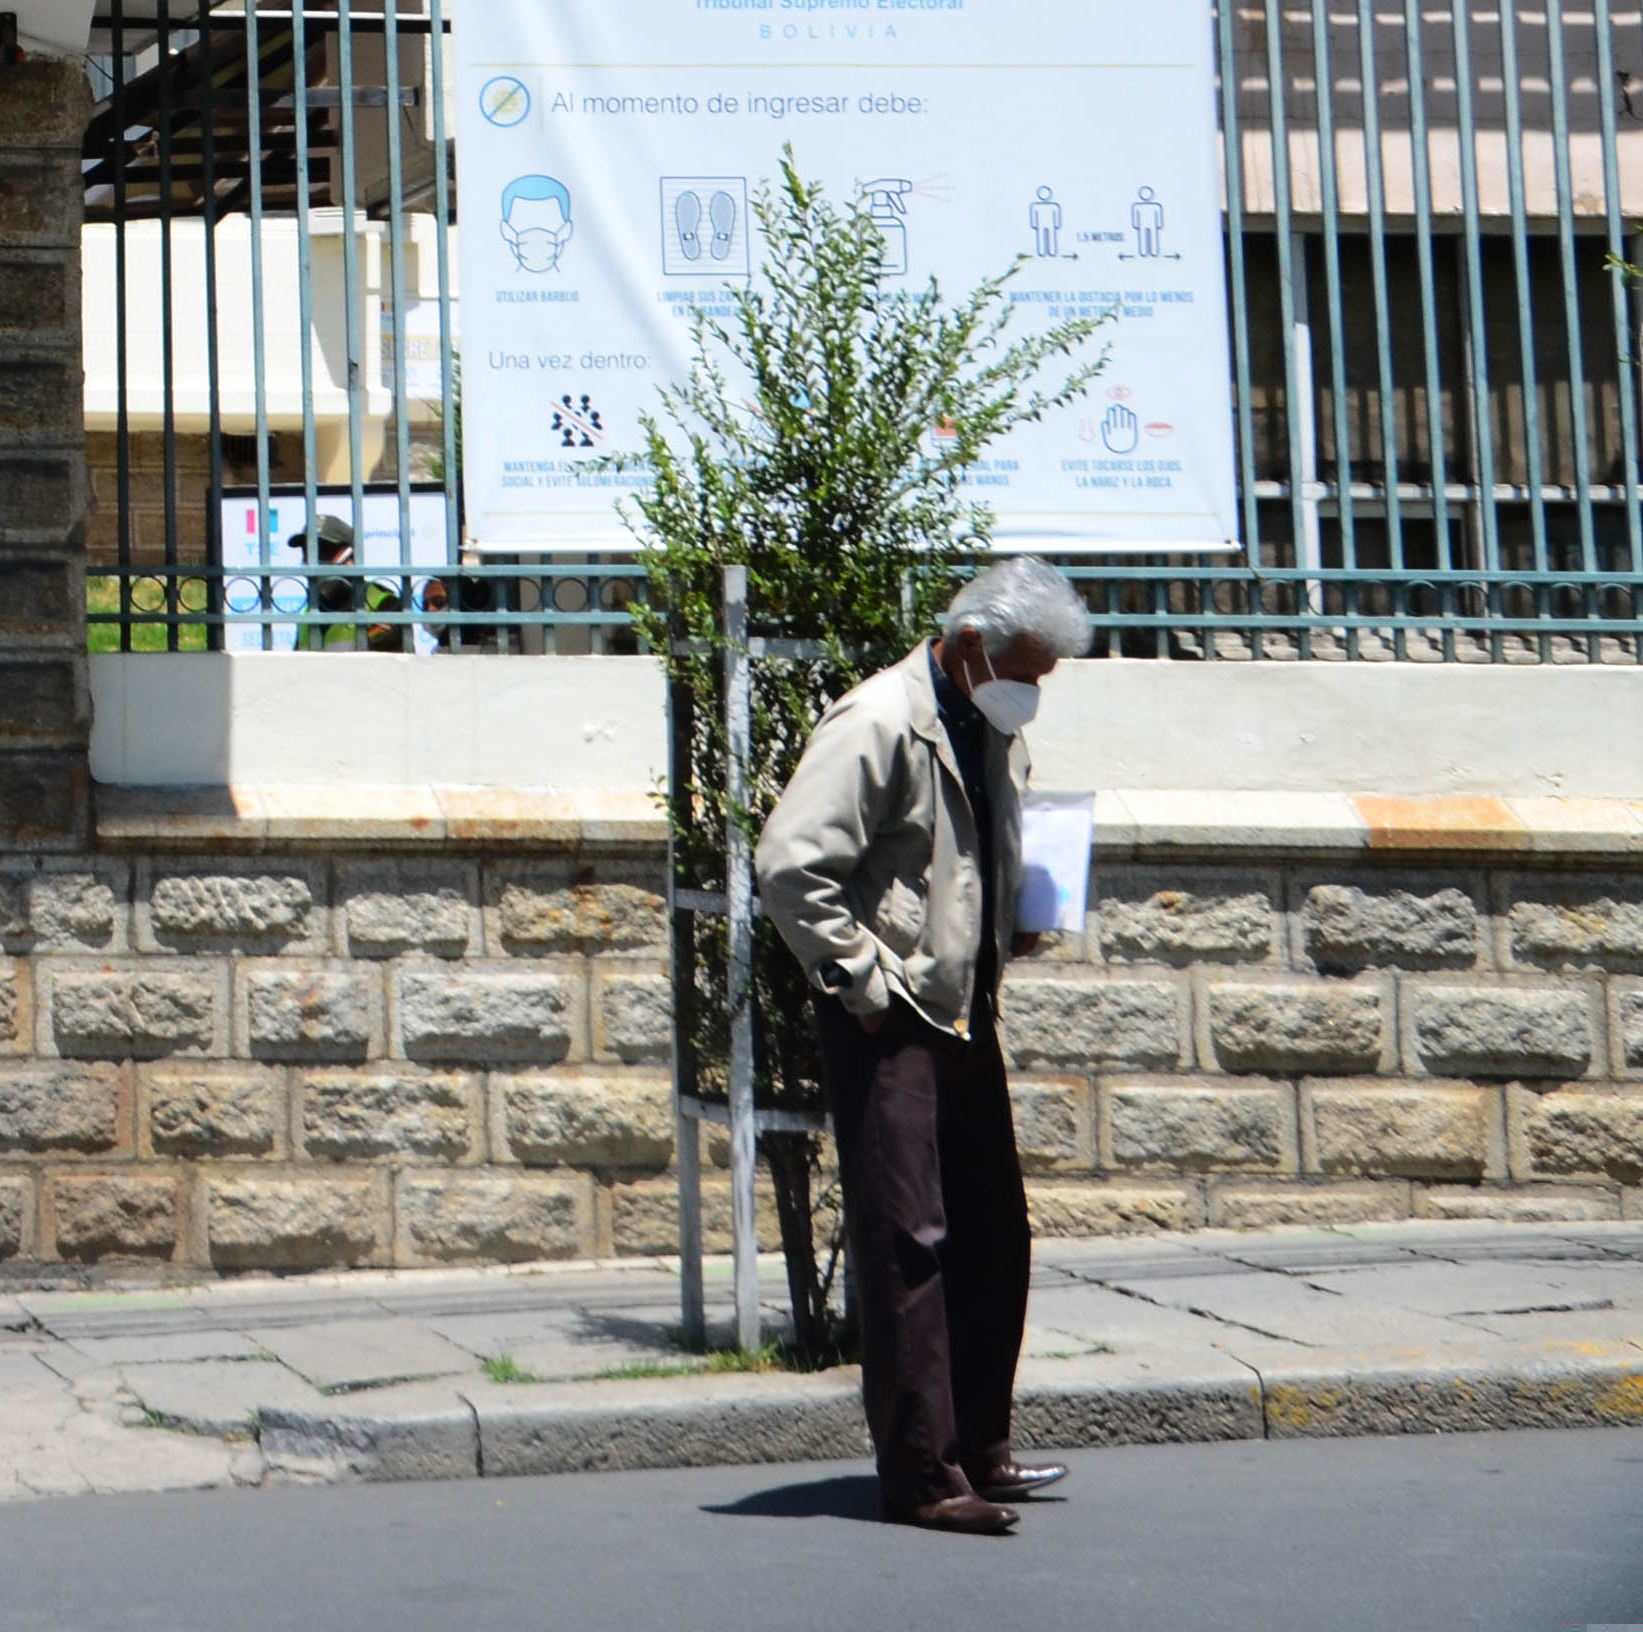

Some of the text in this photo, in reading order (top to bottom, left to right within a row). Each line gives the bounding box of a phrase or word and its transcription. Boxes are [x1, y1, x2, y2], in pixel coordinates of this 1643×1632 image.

[759, 24, 898, 39] BOLIVIA
[551, 91, 929, 119] Al momento de ingresar debe:
[495, 290, 579, 303] UTILIZAR BARBIJO
[488, 351, 651, 370] Una vez dentro:
